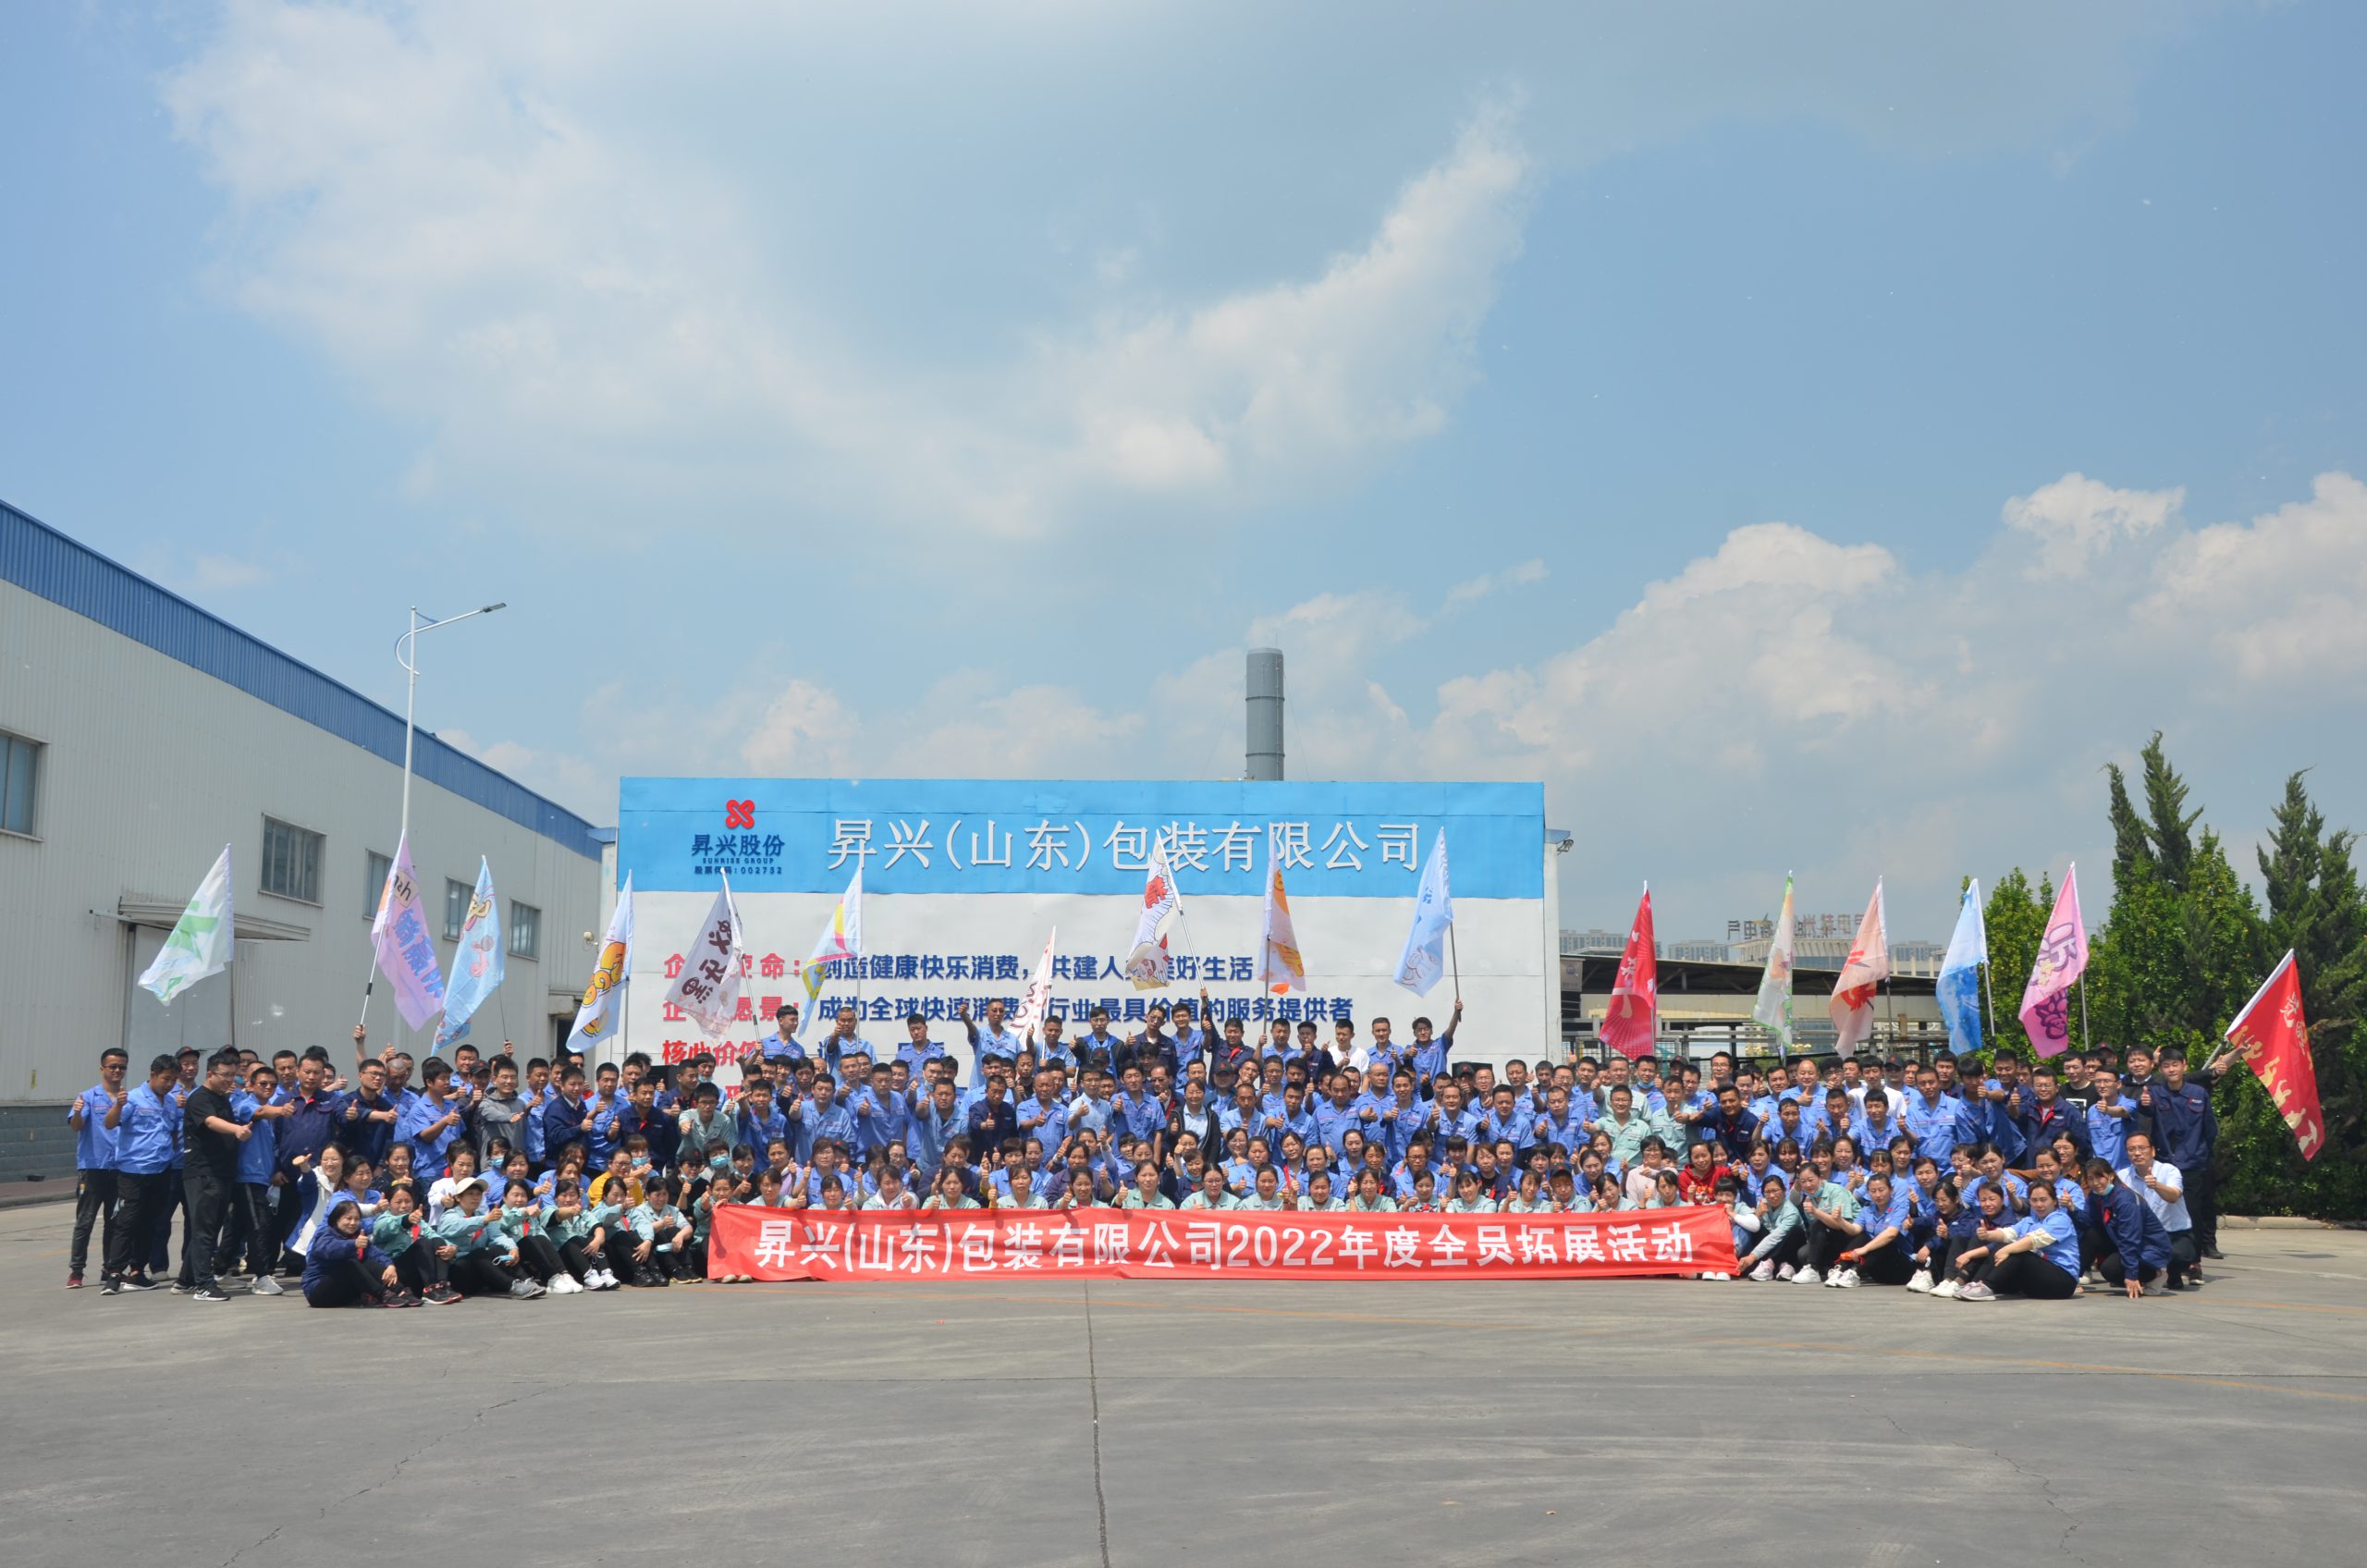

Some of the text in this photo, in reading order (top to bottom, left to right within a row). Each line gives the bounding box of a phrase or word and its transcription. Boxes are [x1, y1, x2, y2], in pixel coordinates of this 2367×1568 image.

[692, 834, 786, 856] 昇兴股份
[828, 818, 1419, 872] 昇兴(山东)包装有限公司
[754, 1219, 1693, 1274] 昇兴(山东)包装有限公司2022年度全员拓展活动
